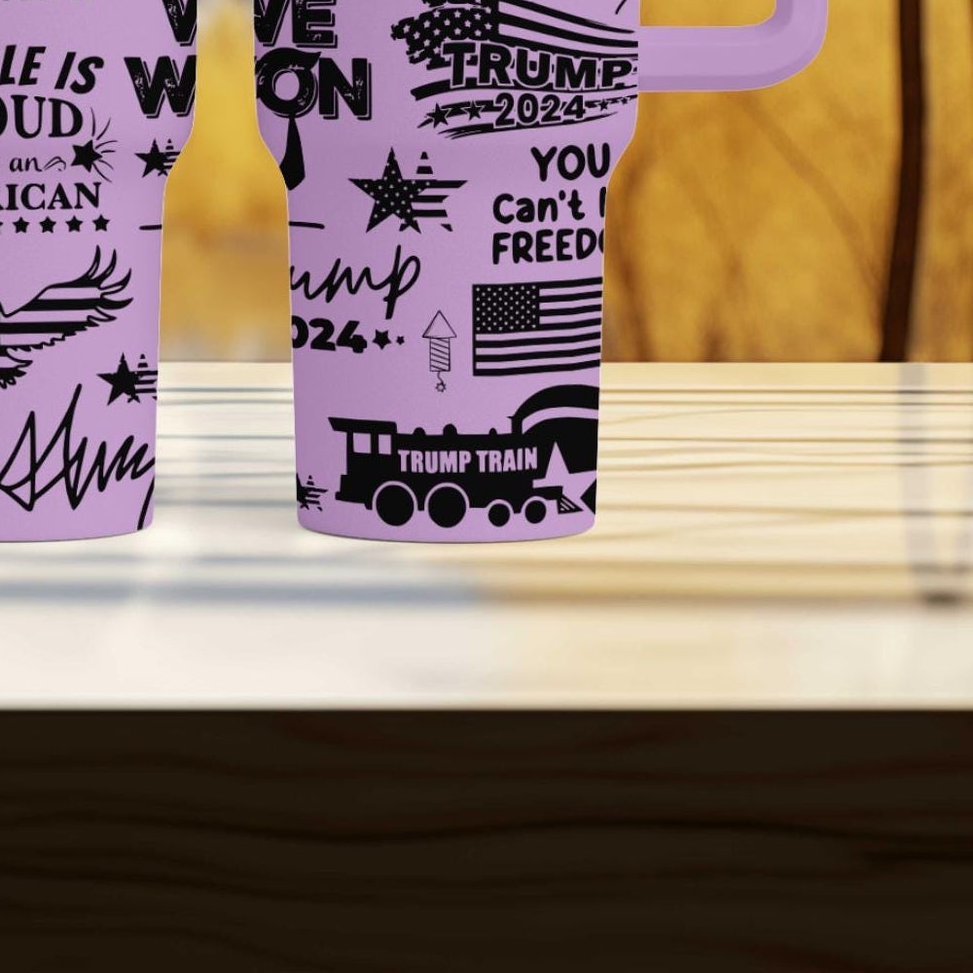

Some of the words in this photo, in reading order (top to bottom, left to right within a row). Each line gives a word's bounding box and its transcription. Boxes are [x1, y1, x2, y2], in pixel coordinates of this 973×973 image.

[54, 51, 105, 94] IS
[442, 41, 633, 90] TRUMP
[494, 92, 586, 128] 2024
[9, 157, 43, 172] an
[530, 142, 610, 182] YOU
[492, 188, 586, 224] Can't
[397, 449, 472, 474] TRUMP
[475, 447, 538, 473] TRAIN
